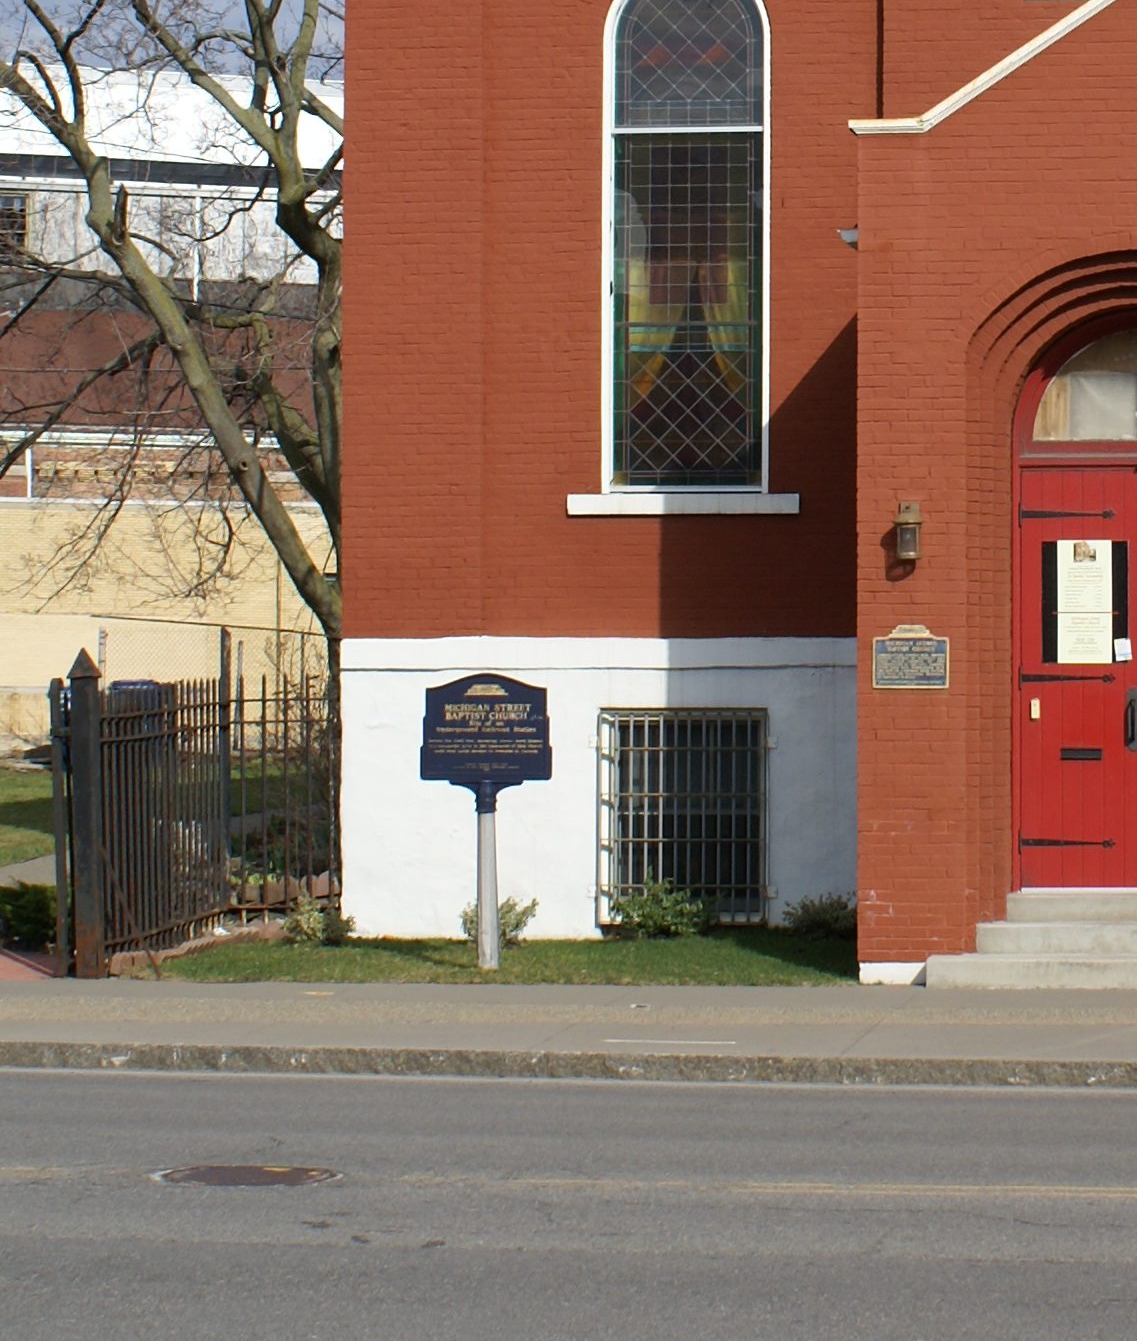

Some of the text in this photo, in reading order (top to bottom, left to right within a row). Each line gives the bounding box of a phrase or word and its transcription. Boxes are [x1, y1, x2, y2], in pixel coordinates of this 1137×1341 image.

[445, 704, 532, 712] MICHIGAN STREET
[445, 712, 528, 720] BAPTIST CHURCH
